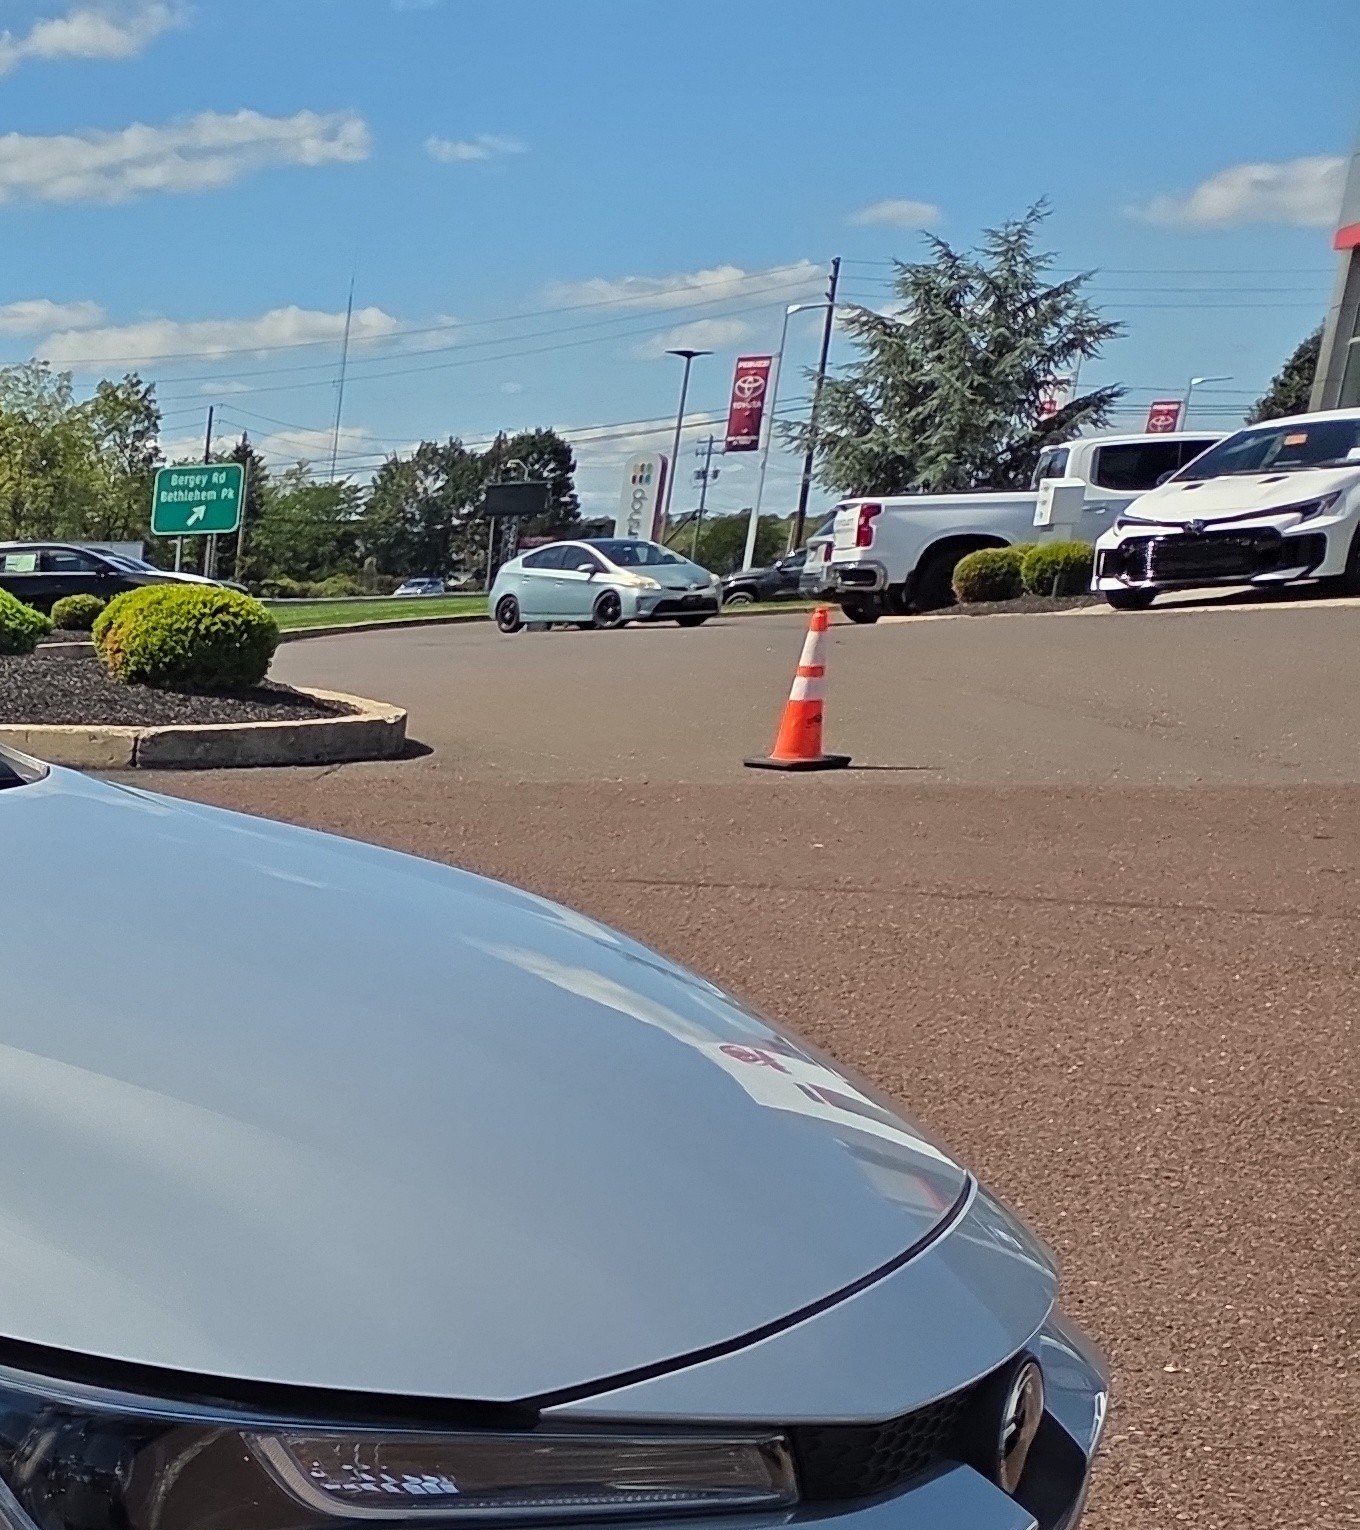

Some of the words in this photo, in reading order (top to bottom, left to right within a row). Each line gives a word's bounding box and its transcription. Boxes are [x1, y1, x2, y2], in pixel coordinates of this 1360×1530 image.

[171, 474, 208, 488] Bergey
[212, 471, 226, 484] Rd
[161, 488, 217, 502] Bethlehem
[221, 487, 235, 499] Pk
